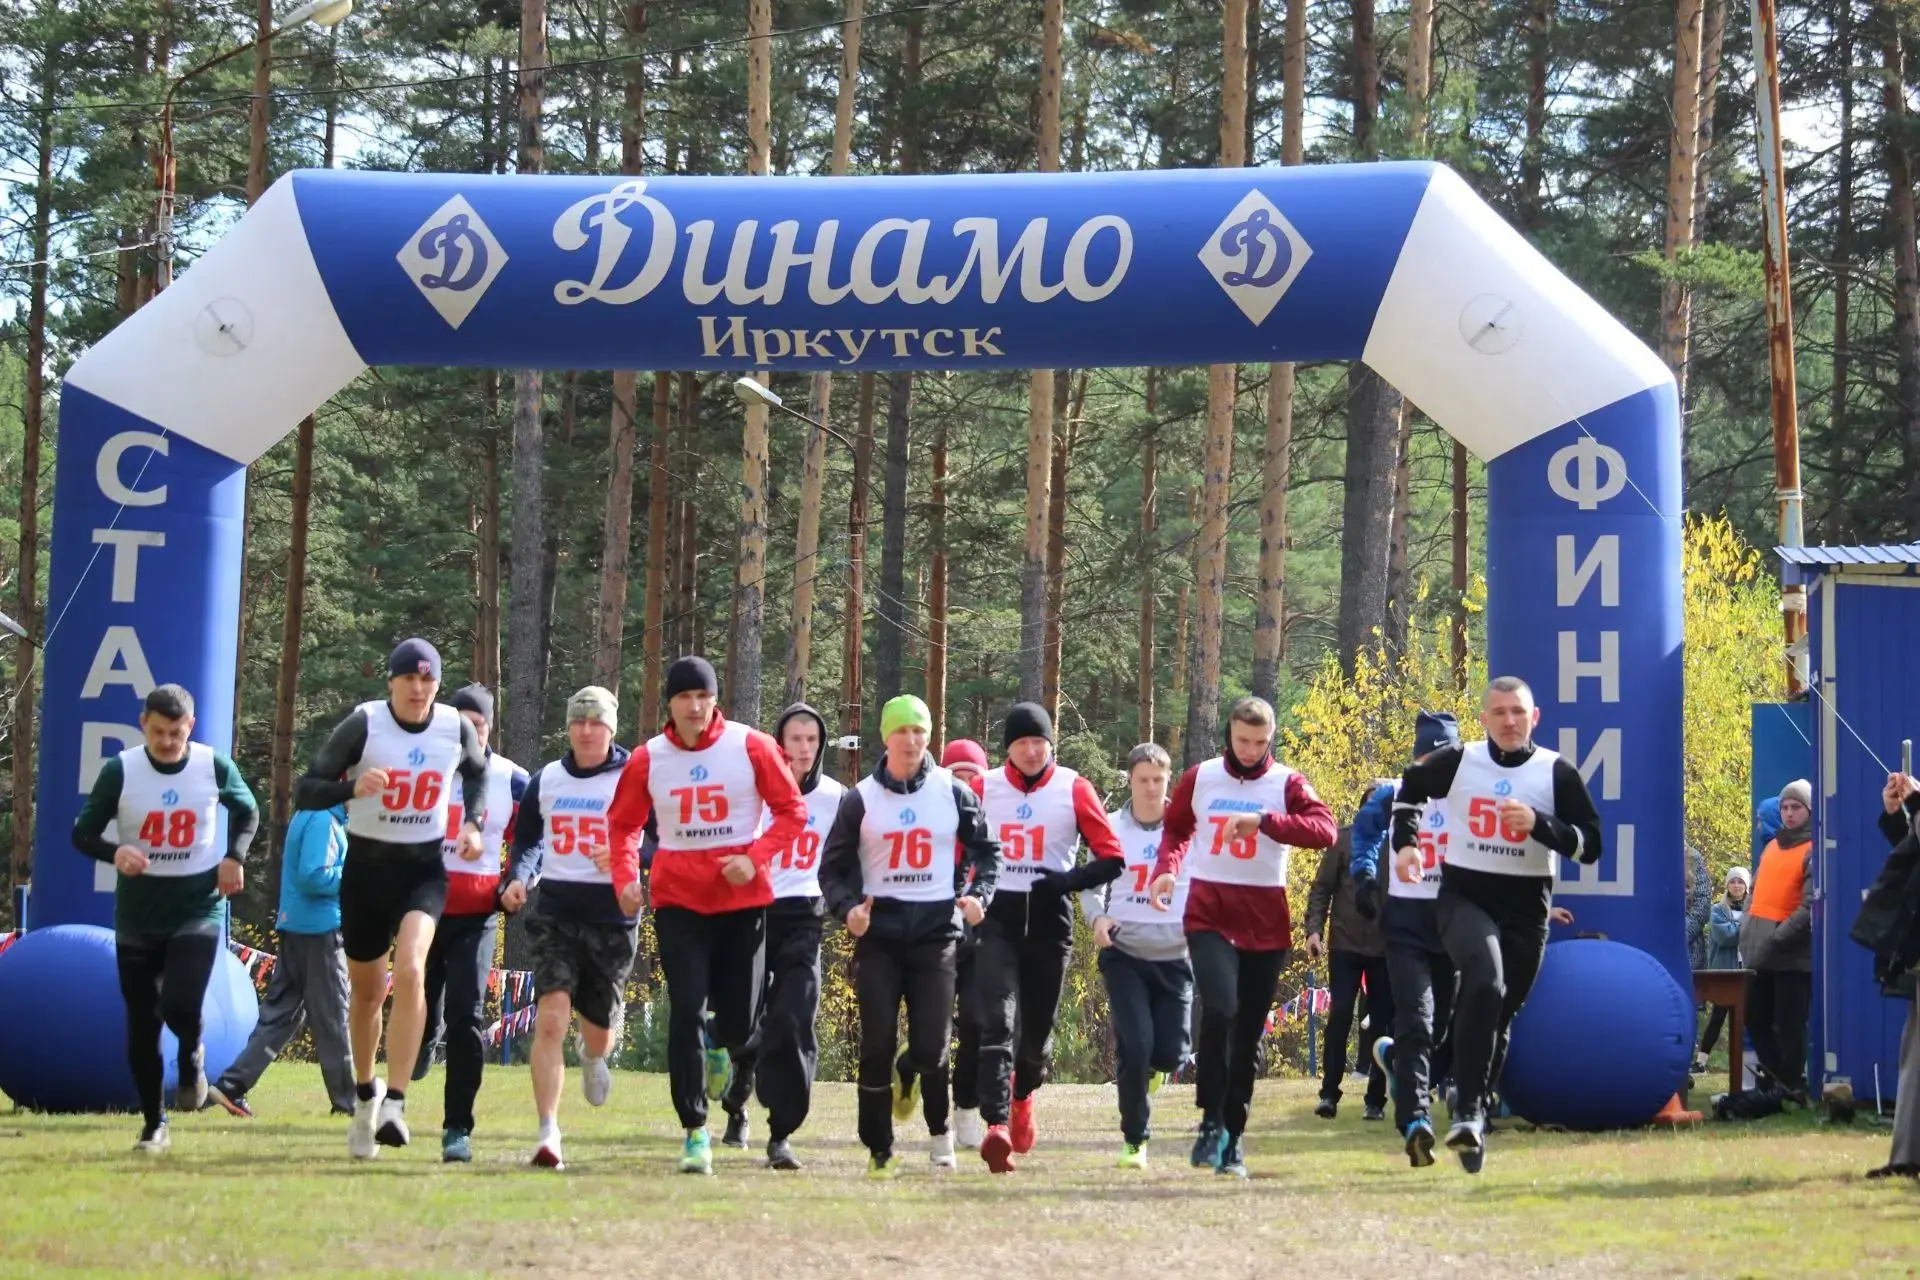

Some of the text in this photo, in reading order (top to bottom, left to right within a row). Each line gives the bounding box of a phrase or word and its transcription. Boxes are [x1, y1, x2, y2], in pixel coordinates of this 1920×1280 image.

[553, 180, 1133, 306] Динамо
[697, 316, 1005, 365] Иркутск
[382, 768, 443, 811] 56
[670, 784, 729, 824] 75
[139, 808, 197, 848] 48
[552, 815, 606, 857] 55
[882, 828, 932, 869] 76
[1000, 824, 1044, 861] 51
